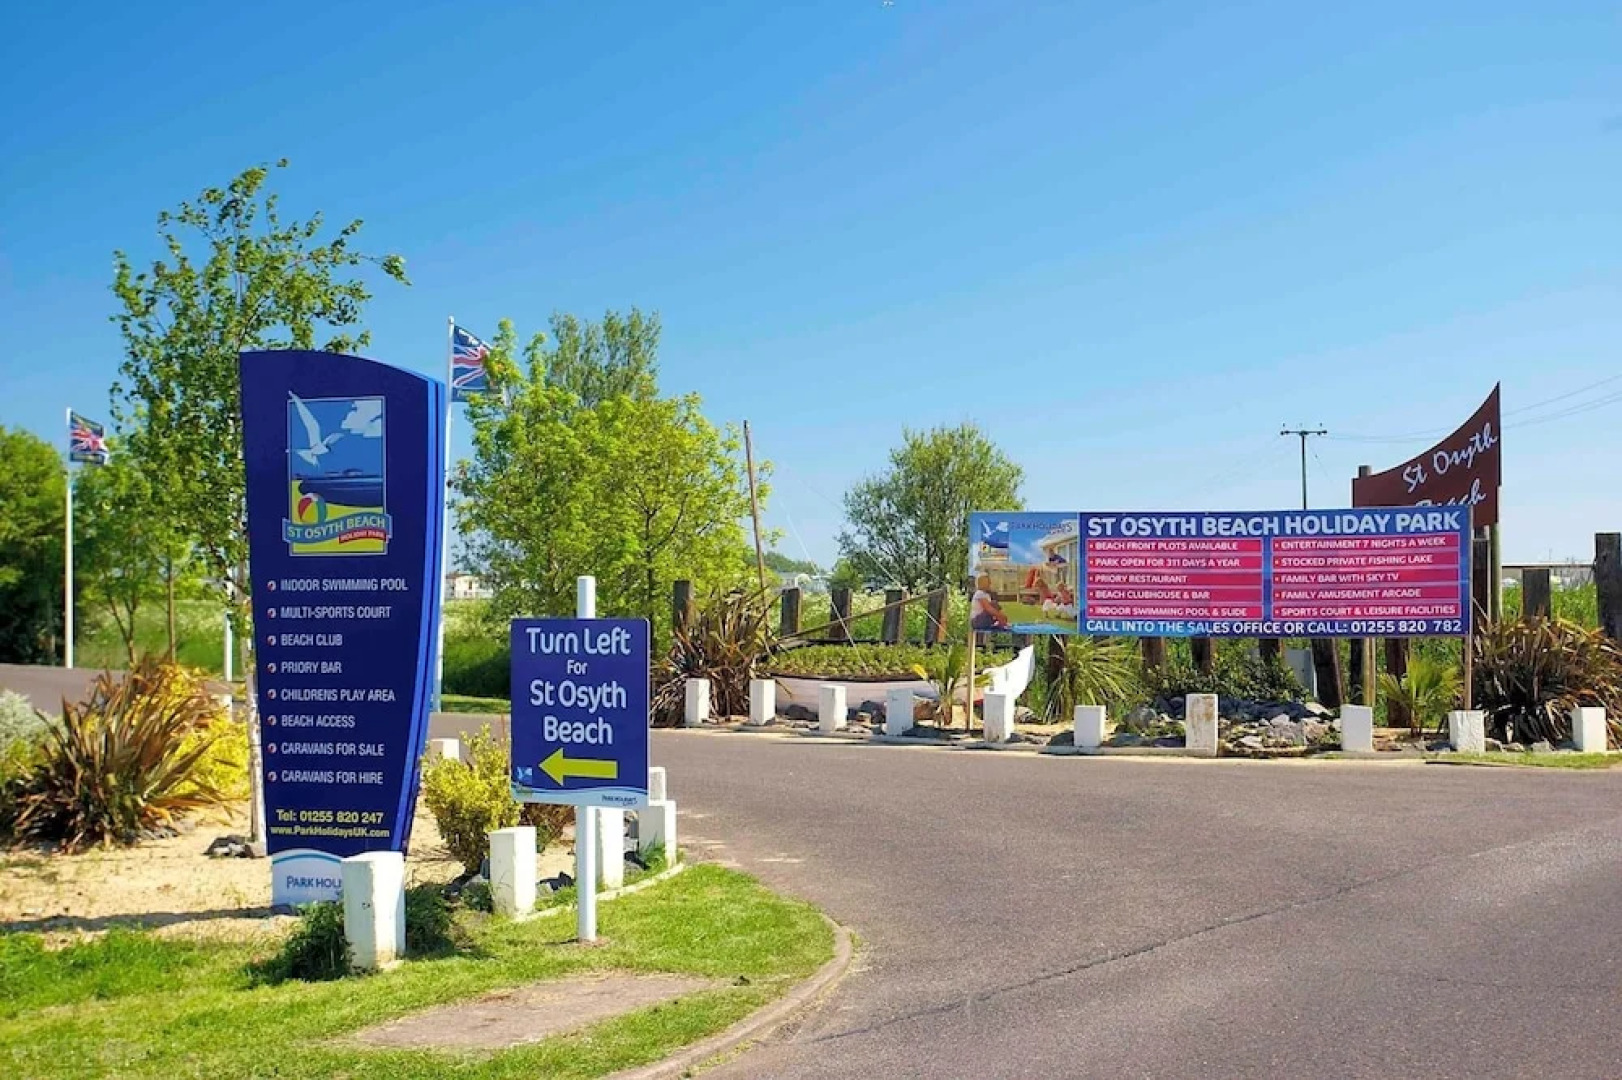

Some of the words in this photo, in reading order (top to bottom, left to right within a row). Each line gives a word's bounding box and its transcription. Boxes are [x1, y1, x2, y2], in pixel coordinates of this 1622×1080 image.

[1402, 463, 1428, 493] St
[288, 526, 303, 538] ST
[304, 521, 343, 539] OSYTH
[346, 515, 385, 529] BEACH
[1087, 517, 1116, 536] ST
[1120, 517, 1197, 536] OSYTH
[1202, 516, 1279, 536] BEACH
[1285, 513, 1391, 535] HOLIDAY
[1395, 511, 1461, 532] PARK
[1095, 542, 1125, 550] BEACH
[1127, 542, 1156, 550] FRONT
[1158, 542, 1187, 550] PLOTS
[1188, 542, 1238, 550] AVAILABLE
[1281, 540, 1362, 550] ENTERTAINMENT
[1363, 540, 1370, 548] 7
[1371, 538, 1407, 548] NIGHTS
[1408, 538, 1416, 546] A
[1417, 537, 1446, 546] WEEK
[1095, 559, 1119, 567] PARK
[1120, 558, 1145, 567] OPEN
[1147, 558, 1164, 567] FOR
[1166, 558, 1180, 567] 311
[1181, 559, 1206, 567] DAYS
[1207, 559, 1215, 567] A
[1216, 559, 1240, 567] YEAR
[1281, 558, 1325, 566] STOCKED
[1326, 557, 1366, 566] PRIVATE
[1368, 556, 1406, 565] FISHING
[1408, 555, 1433, 564] LAKE
[1094, 575, 1128, 583] PRIORY
[1129, 575, 1187, 583] RESTAURANT
[1281, 574, 1316, 583] FAMILY
[1318, 574, 1339, 583] BAR
[1339, 574, 1365, 582] WITH
[1366, 573, 1385, 582] SKY
[1387, 573, 1399, 581] TV
[281, 579, 320, 591] INDOOR
[322, 579, 378, 591] SWIMMING
[380, 579, 408, 590] POOL
[1095, 590, 1125, 598] BEACH
[1127, 590, 1181, 598] CLUBHOUSE
[1183, 591, 1190, 599] &
[1192, 591, 1210, 599] BAR
[1281, 590, 1317, 599] FAMILY
[1317, 590, 1379, 599] AMUSEMENT
[1381, 589, 1421, 598] ARCADE
[281, 606, 354, 618] MULTI-SPORTS
[357, 606, 391, 618] COURT
[1095, 608, 1131, 616] INDOOR
[1133, 608, 1183, 616] SWIMMING
[1185, 608, 1210, 616] POOL
[1212, 608, 1219, 616] &
[1221, 608, 1247, 616] SLIDE
[1281, 608, 1317, 616] SPORTS
[1320, 608, 1351, 616] COURT
[1353, 608, 1361, 616] &
[1363, 606, 1403, 615] LEISURE
[1404, 605, 1455, 614] FACILITIES
[1086, 620, 1119, 632] CALL
[1122, 620, 1154, 632] INTO
[1157, 621, 1185, 632] THE
[1187, 622, 1230, 633] SALES
[1233, 622, 1281, 633] OFFICE
[1284, 622, 1305, 633] OR
[1350, 621, 1395, 632] 01255
[1398, 620, 1427, 632] 820
[1433, 620, 1462, 632] 782
[281, 634, 313, 646] BEACH
[316, 634, 343, 646] CLUB
[526, 627, 578, 654] Turn
[584, 626, 632, 656] Left
[281, 662, 318, 673] PRIORY
[321, 662, 342, 673] BAR
[567, 659, 588, 675] For
[281, 689, 338, 701] CHILDRENS
[340, 689, 366, 701] PLAY
[368, 689, 396, 701] AREA
[530, 679, 555, 706] St
[558, 680, 627, 714] Osyth
[281, 715, 313, 727] BEACH
[316, 715, 355, 728] ACCESS
[544, 716, 613, 744] Beach
[281, 742, 334, 755] CARAVANS
[336, 743, 356, 755] FOR
[358, 743, 384, 756] SALE
[281, 771, 334, 783] CARAVANS
[336, 772, 356, 784] FOR
[359, 772, 384, 785] HIRE
[276, 809, 297, 821] Tel:
[300, 811, 333, 822] 01255
[336, 811, 358, 823] 820
[362, 812, 384, 824] 247
[270, 826, 390, 838] www.ParkHolidaysUK.com
[287, 875, 314, 889] PARK
